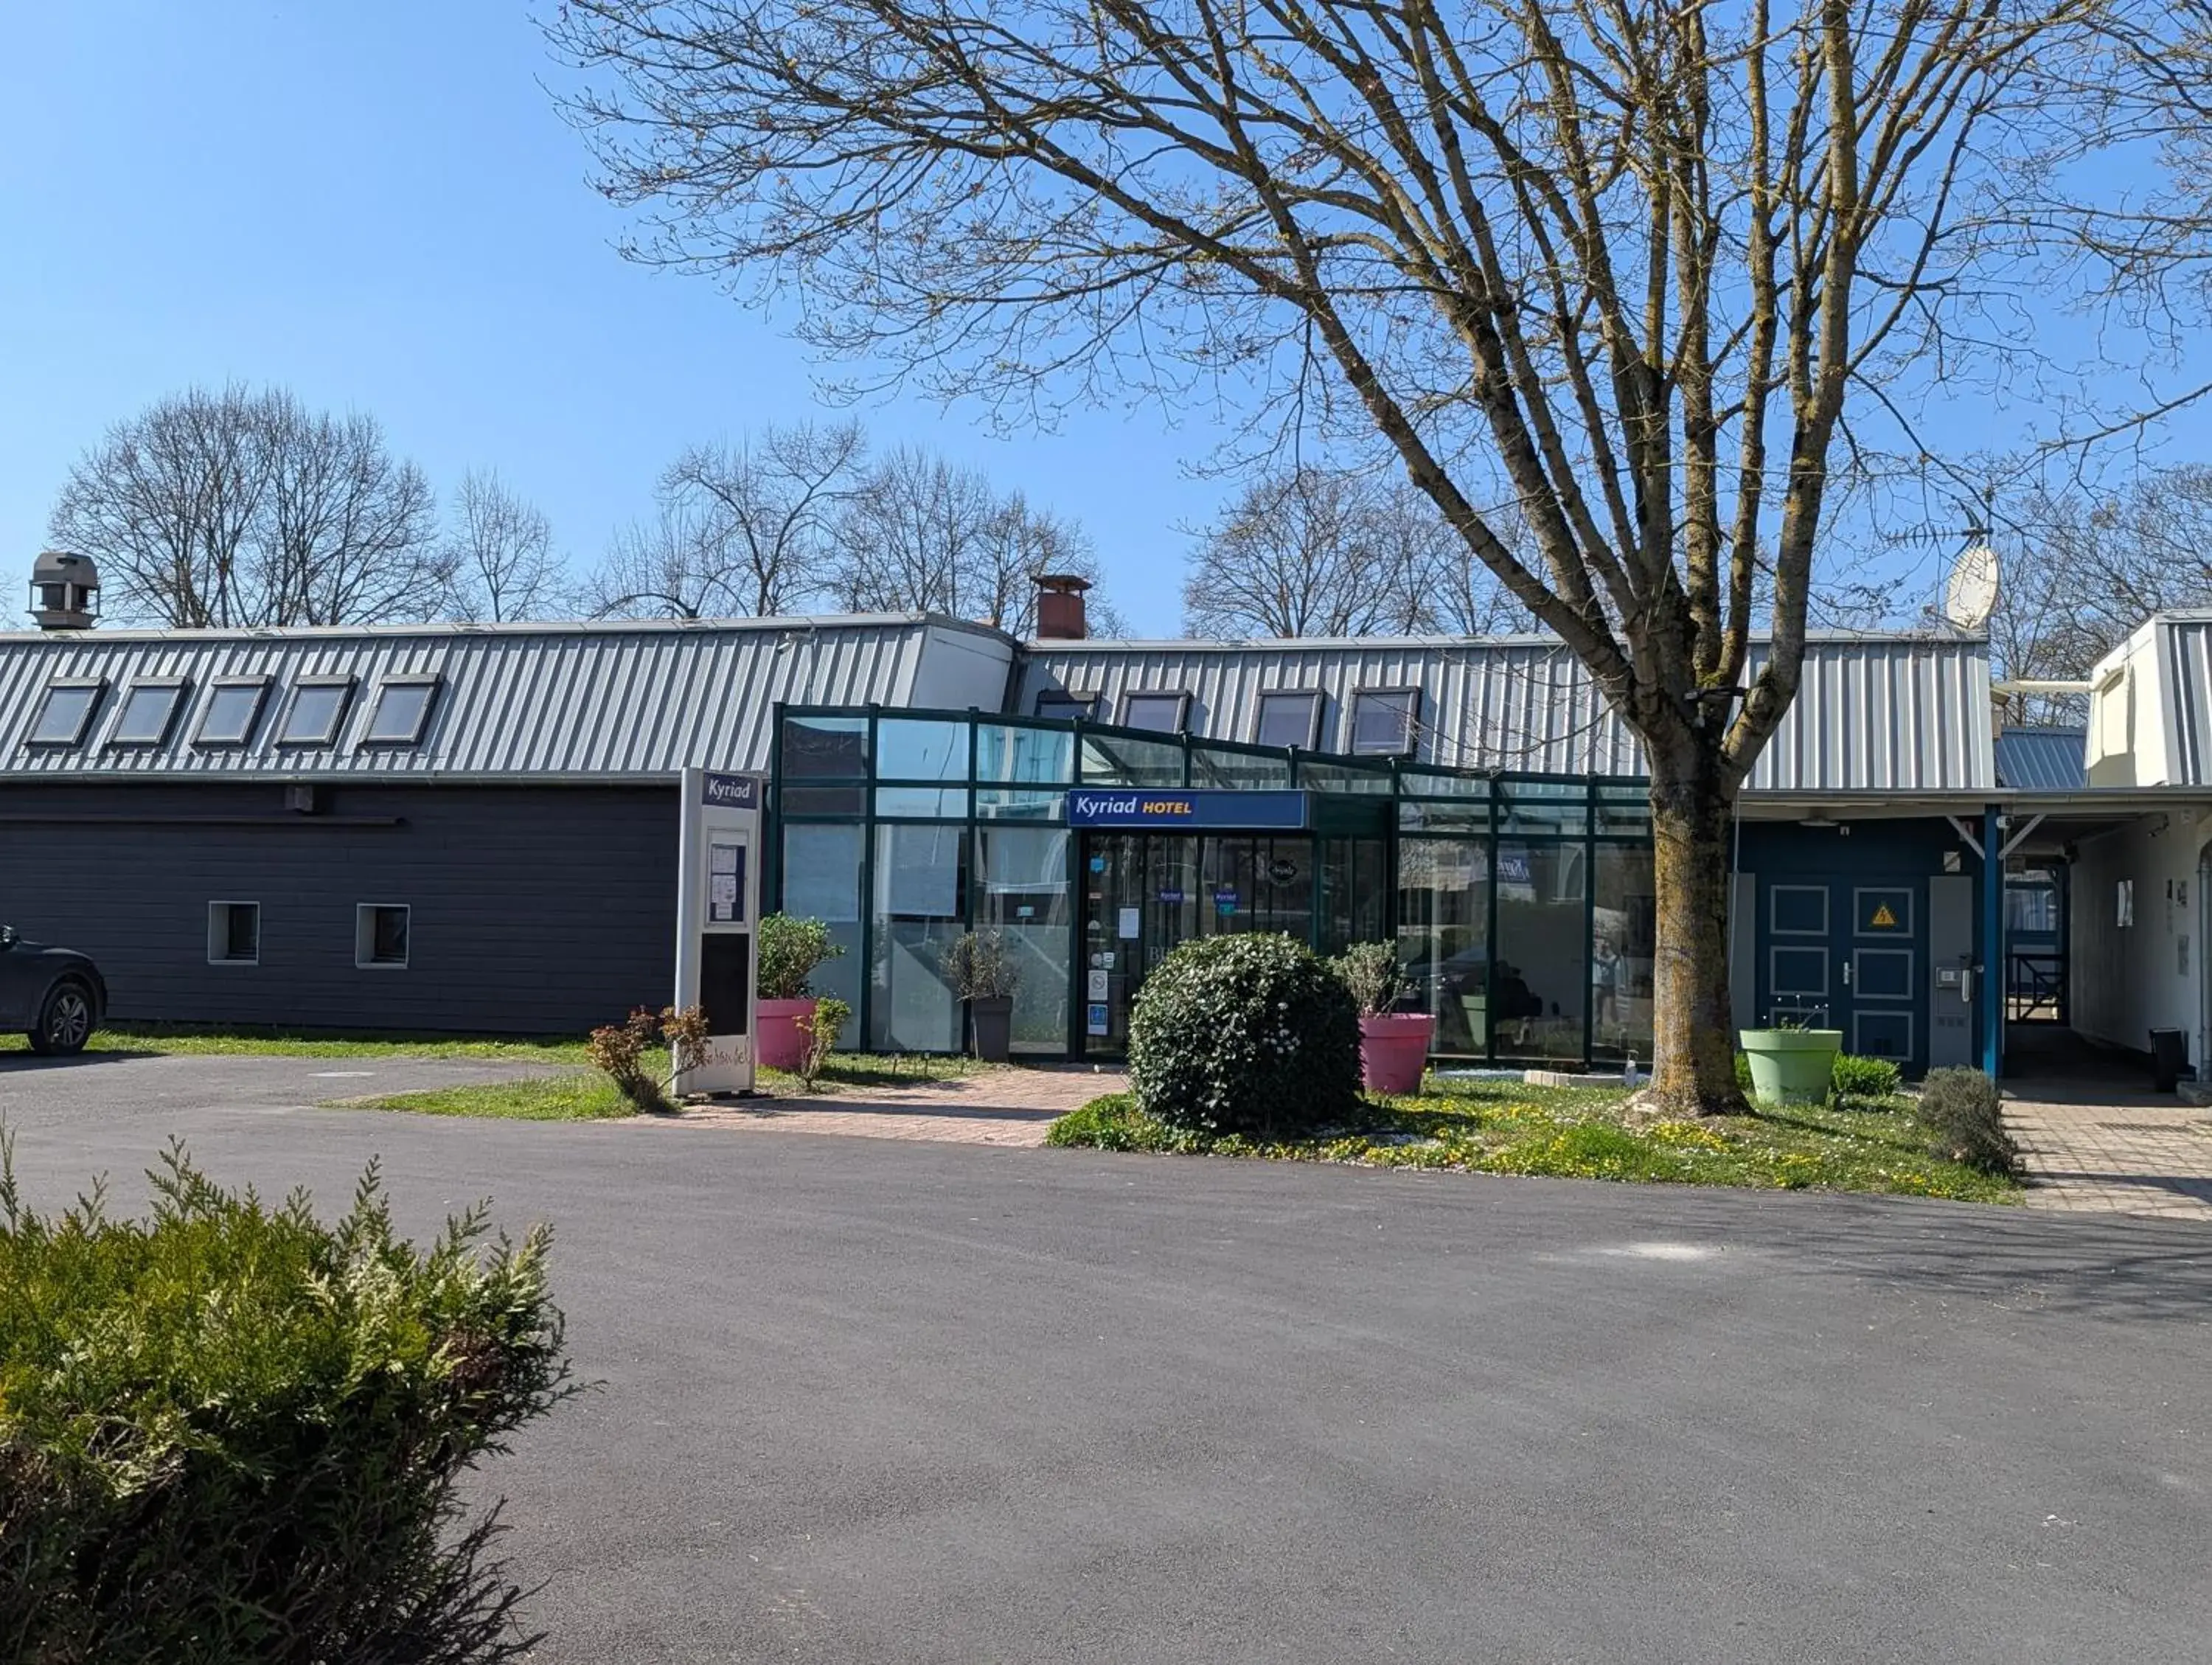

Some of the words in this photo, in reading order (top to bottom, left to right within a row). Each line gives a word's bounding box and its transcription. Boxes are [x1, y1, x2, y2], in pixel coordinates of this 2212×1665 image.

[709, 778, 751, 800] Kyriad
[1076, 796, 1137, 818] Kyriad
[1142, 802, 1192, 814] HOTEL
